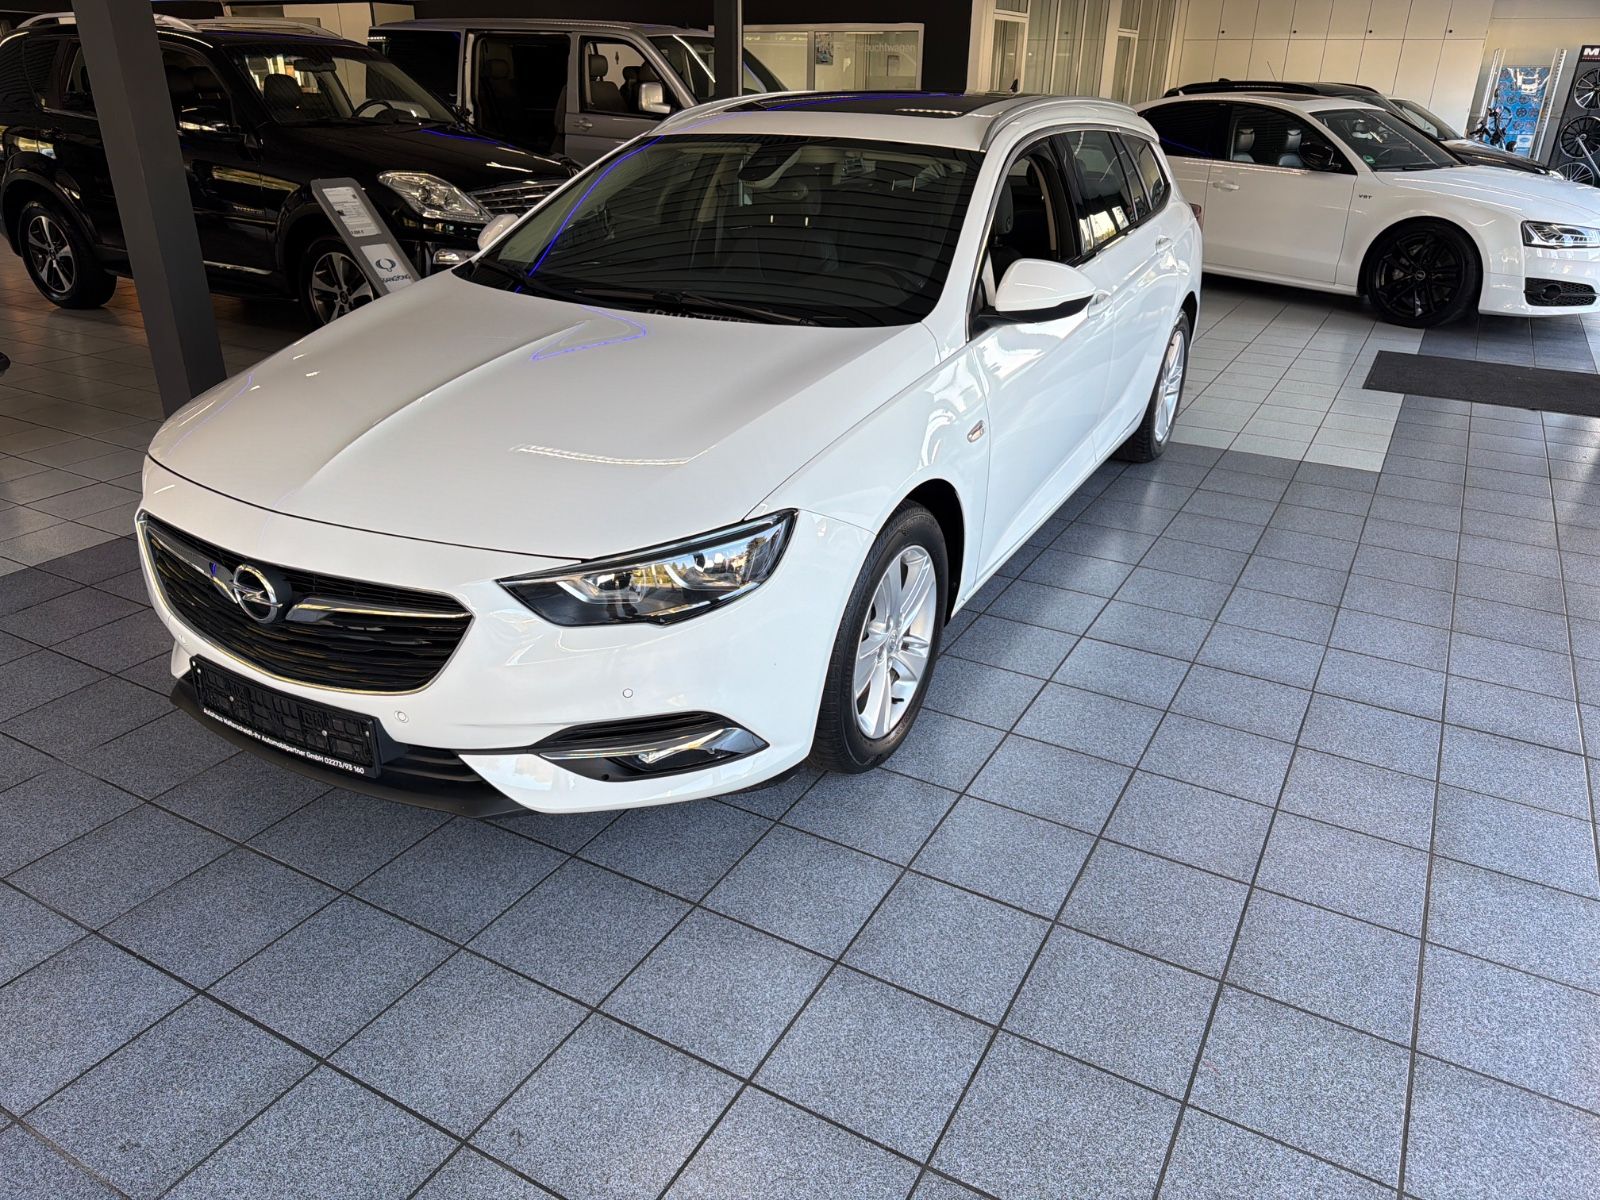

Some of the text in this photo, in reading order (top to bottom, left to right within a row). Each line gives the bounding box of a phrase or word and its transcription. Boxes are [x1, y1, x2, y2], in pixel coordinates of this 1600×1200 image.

[203, 707, 224, 721] Autohaus
[306, 751, 324, 763] GmbH
[324, 757, 353, 771] 02273/93
[353, 765, 365, 775] 160
